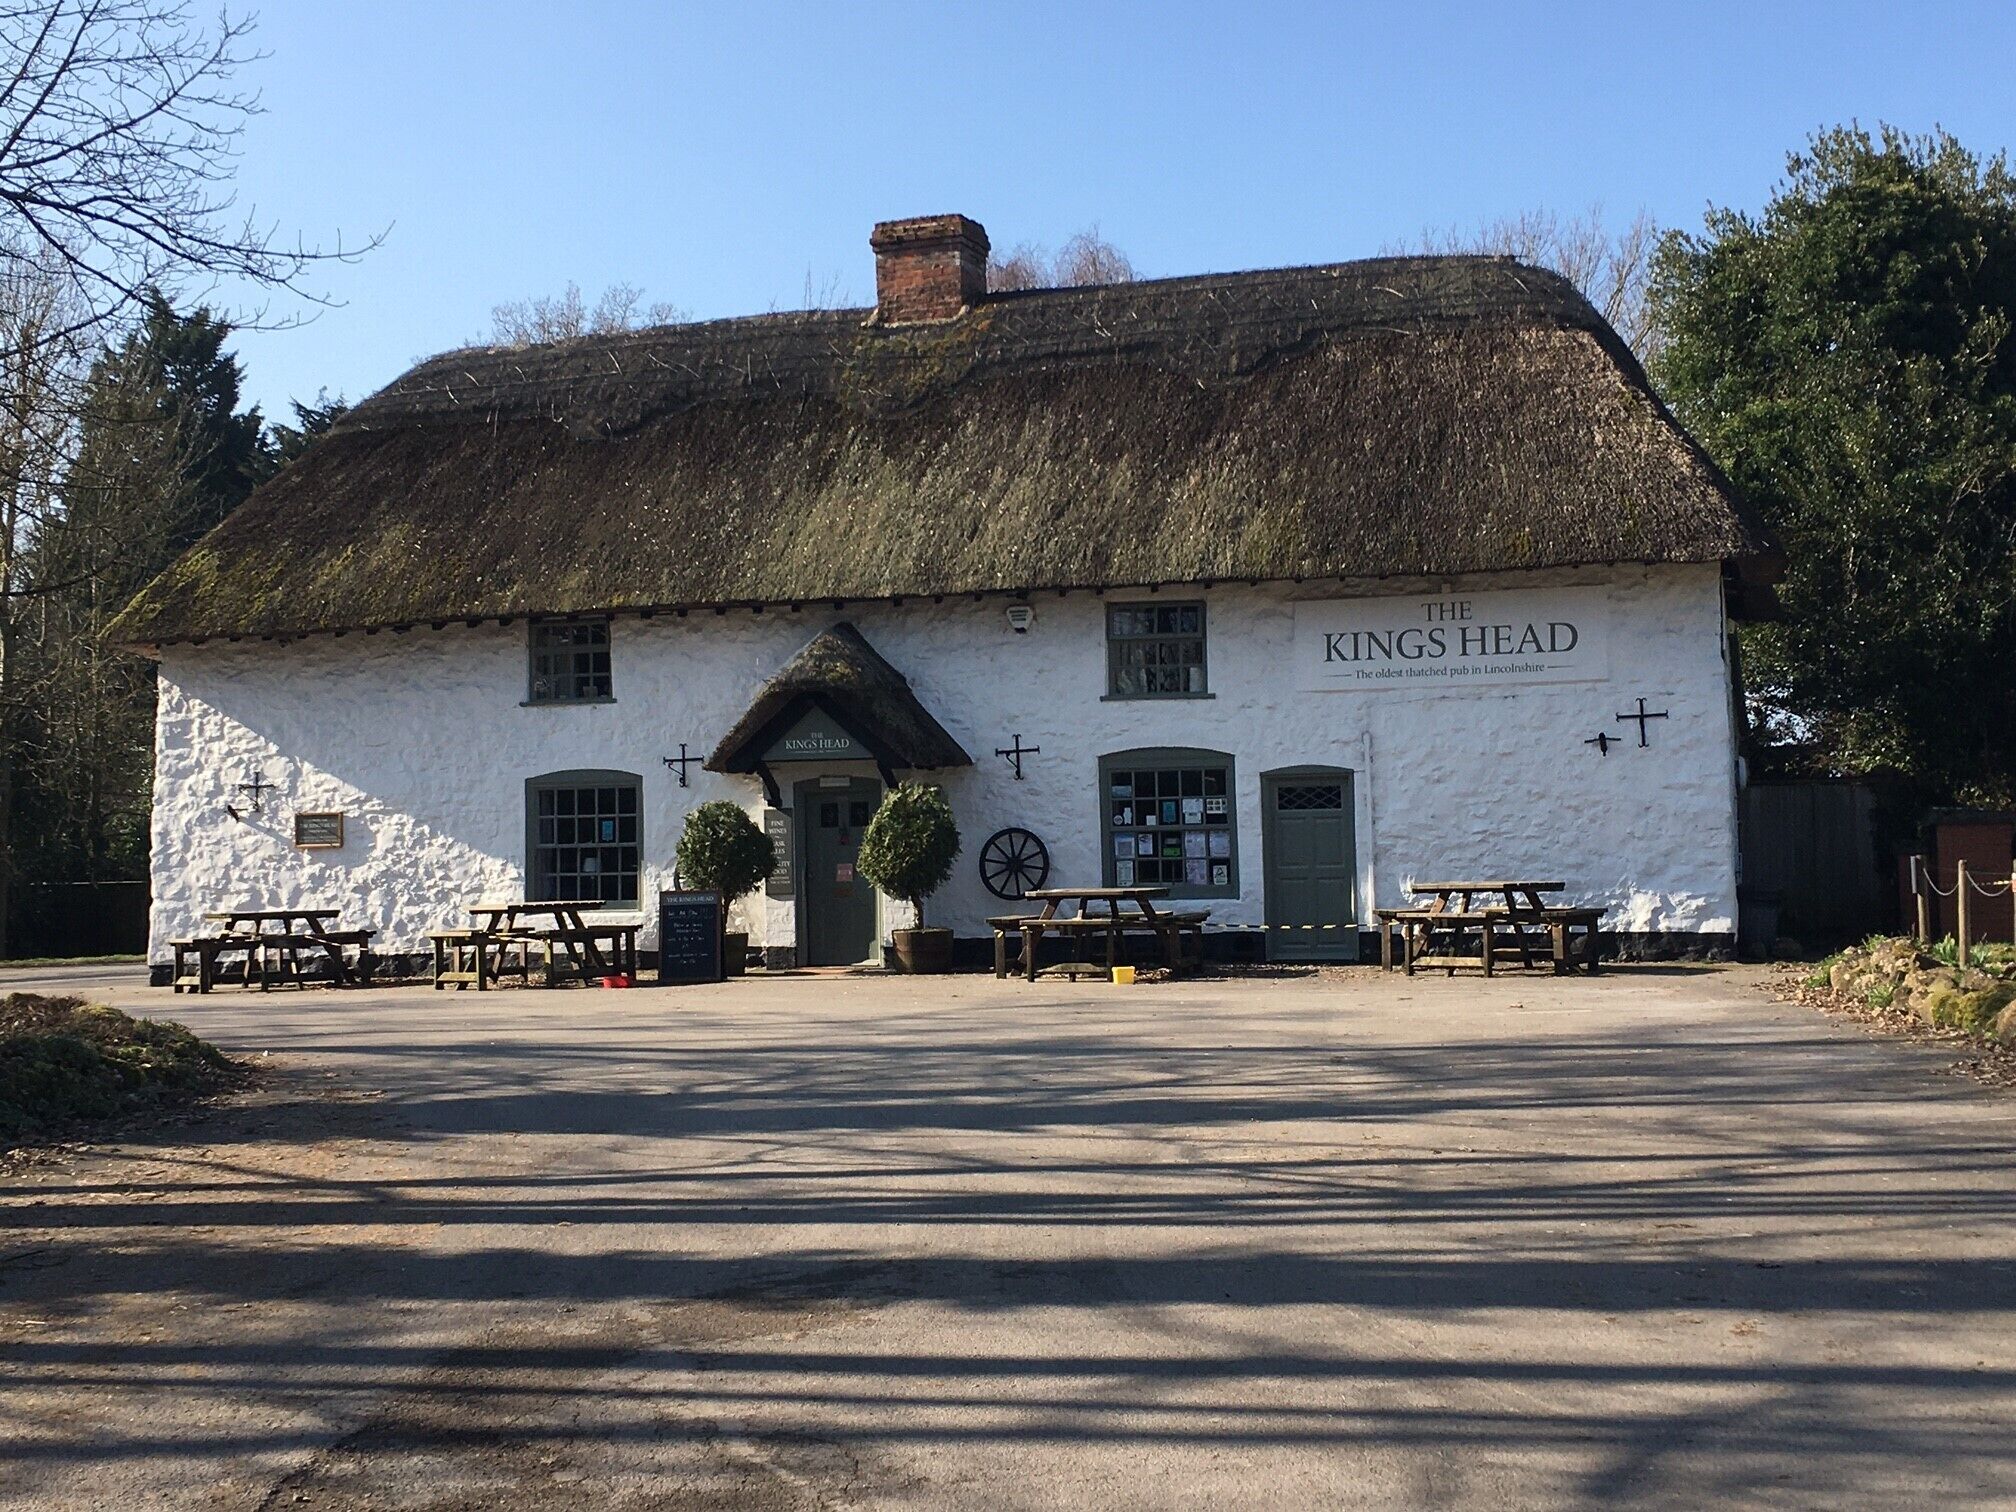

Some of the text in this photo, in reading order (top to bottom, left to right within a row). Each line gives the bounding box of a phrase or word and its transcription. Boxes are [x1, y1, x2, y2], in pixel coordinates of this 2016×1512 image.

[1421, 601, 1472, 622] THE
[1324, 622, 1578, 662] KINGS HEAD
[1355, 662, 1545, 679] The oldest thatched pub in Lincolnshire
[785, 739, 850, 750] KINGS HEAD
